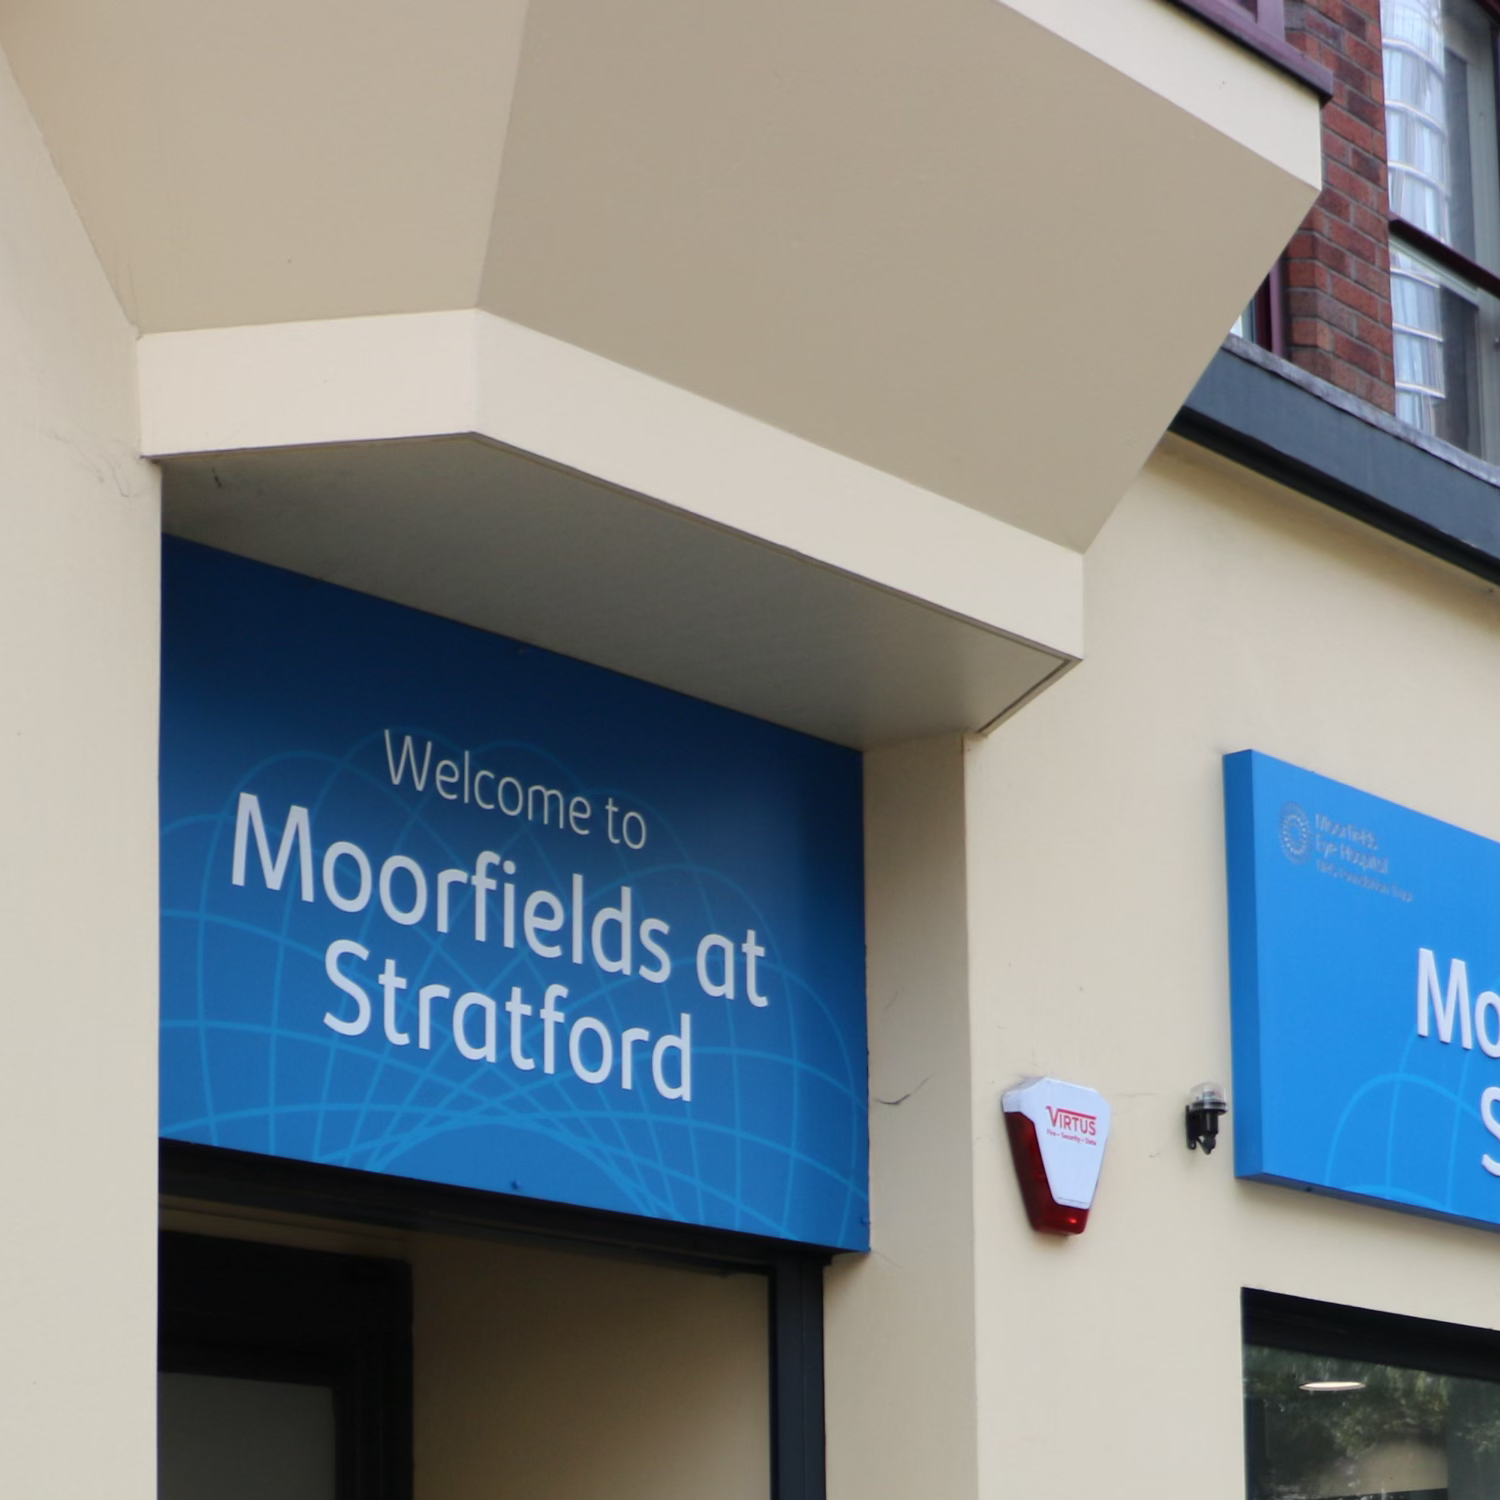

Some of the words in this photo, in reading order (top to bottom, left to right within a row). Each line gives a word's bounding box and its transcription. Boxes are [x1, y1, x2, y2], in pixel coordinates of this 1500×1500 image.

[384, 728, 591, 836] Welcome
[605, 796, 647, 850] to
[231, 791, 672, 985] Moorfields
[696, 928, 769, 1008] at
[322, 938, 692, 1102] Stratford
[1045, 1105, 1097, 1136] VIRTUS
